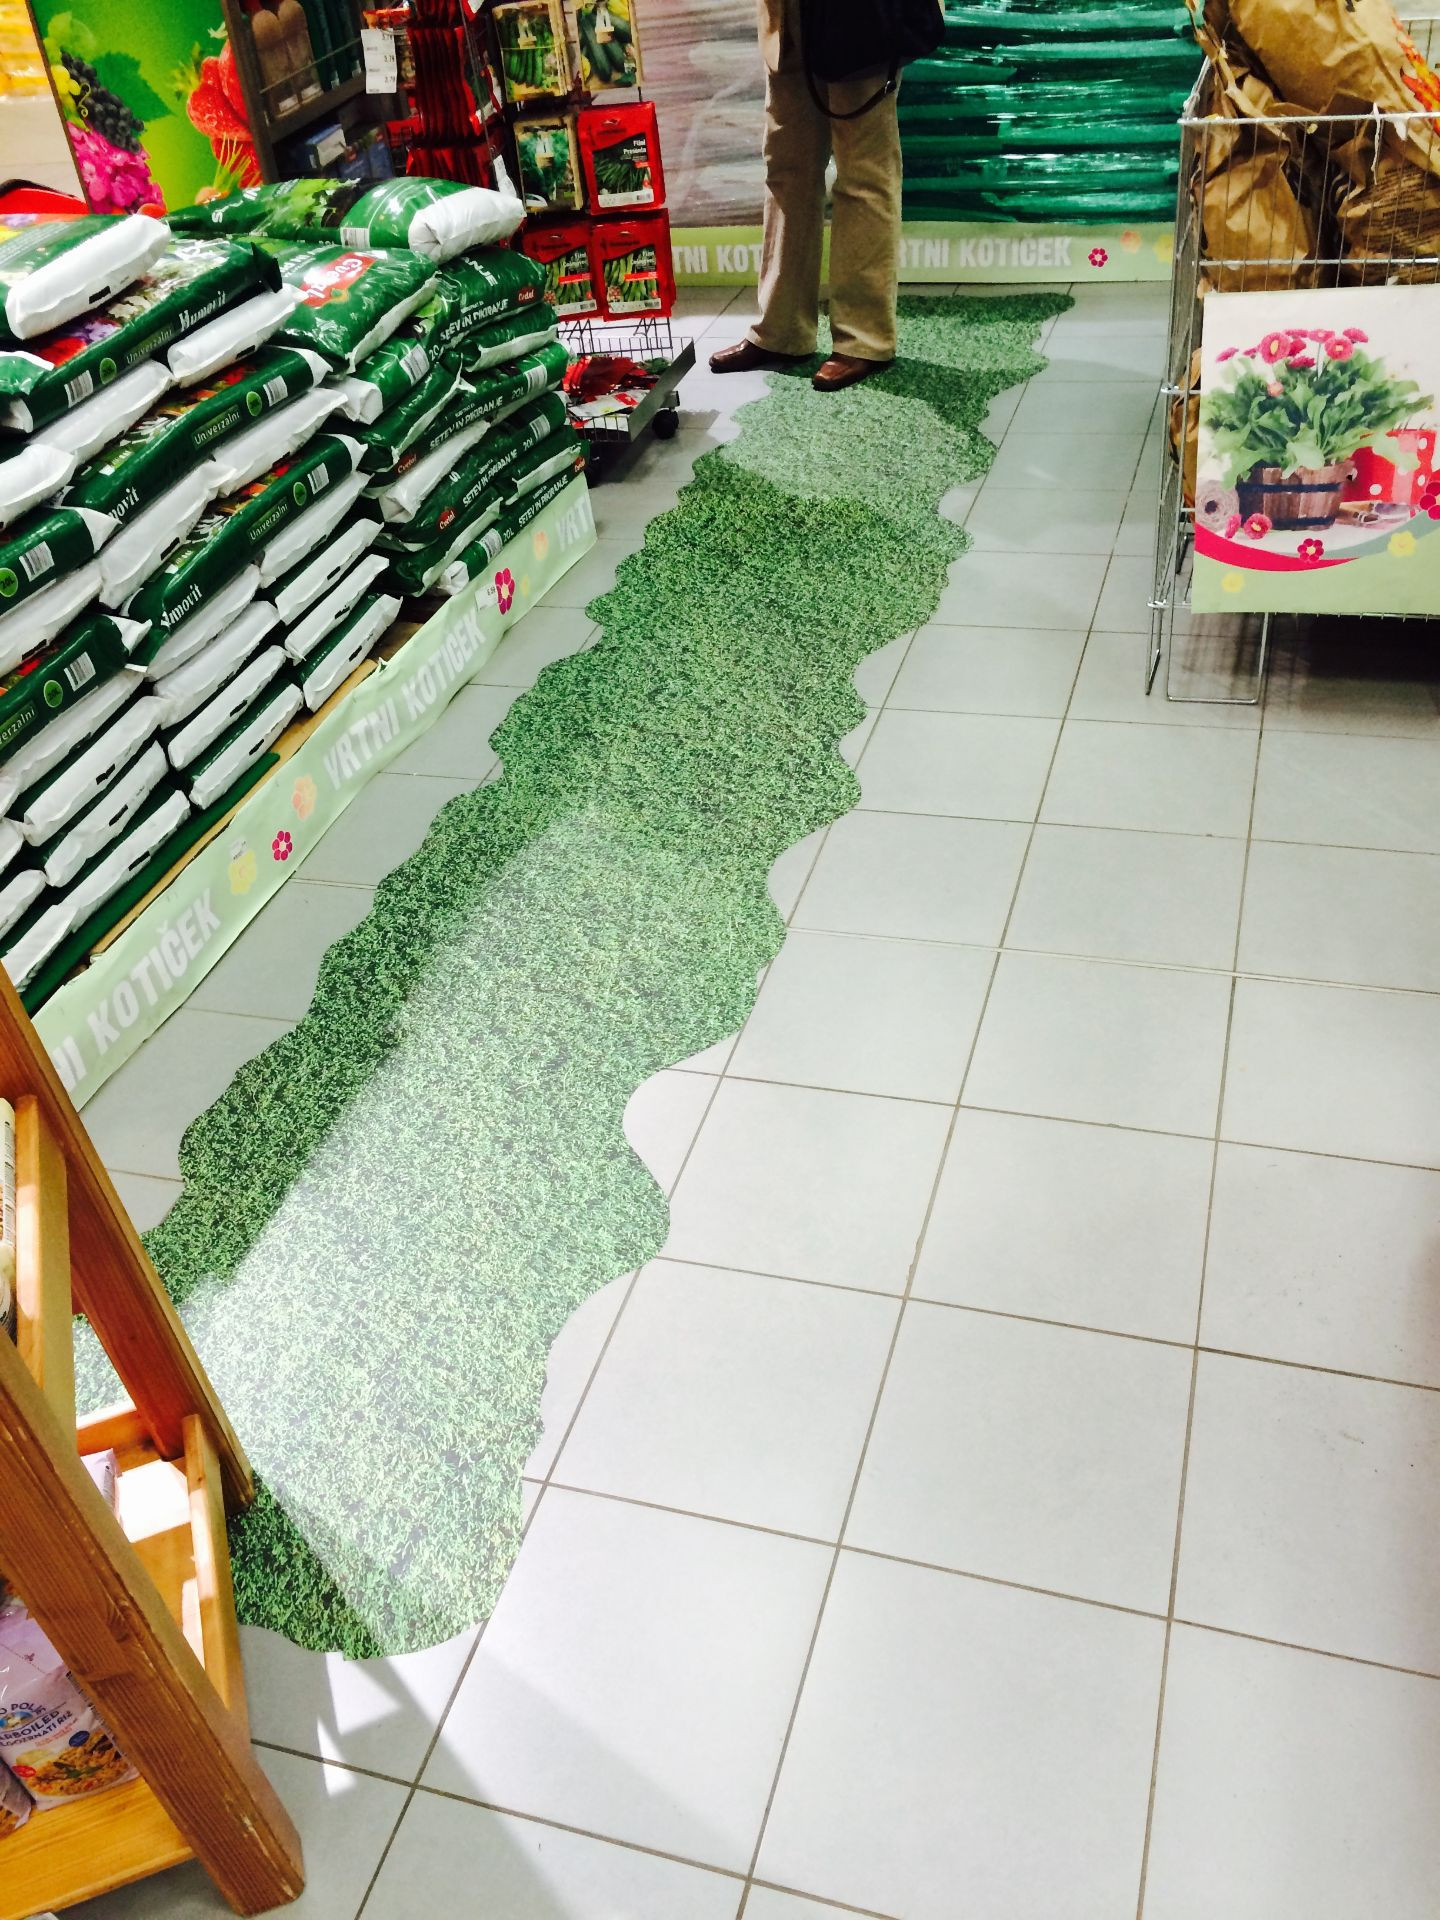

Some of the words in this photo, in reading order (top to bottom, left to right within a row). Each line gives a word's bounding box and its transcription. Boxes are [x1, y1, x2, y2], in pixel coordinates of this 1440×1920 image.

[672, 245, 708, 273] TNI
[715, 244, 763, 272] KOT
[959, 232, 1073, 267] KOTIČEK
[193, 410, 241, 445] Univerzalni
[249, 503, 289, 541] Univerzalni
[323, 697, 401, 791] VRTNI
[86, 888, 221, 1056] KOTIČEK
